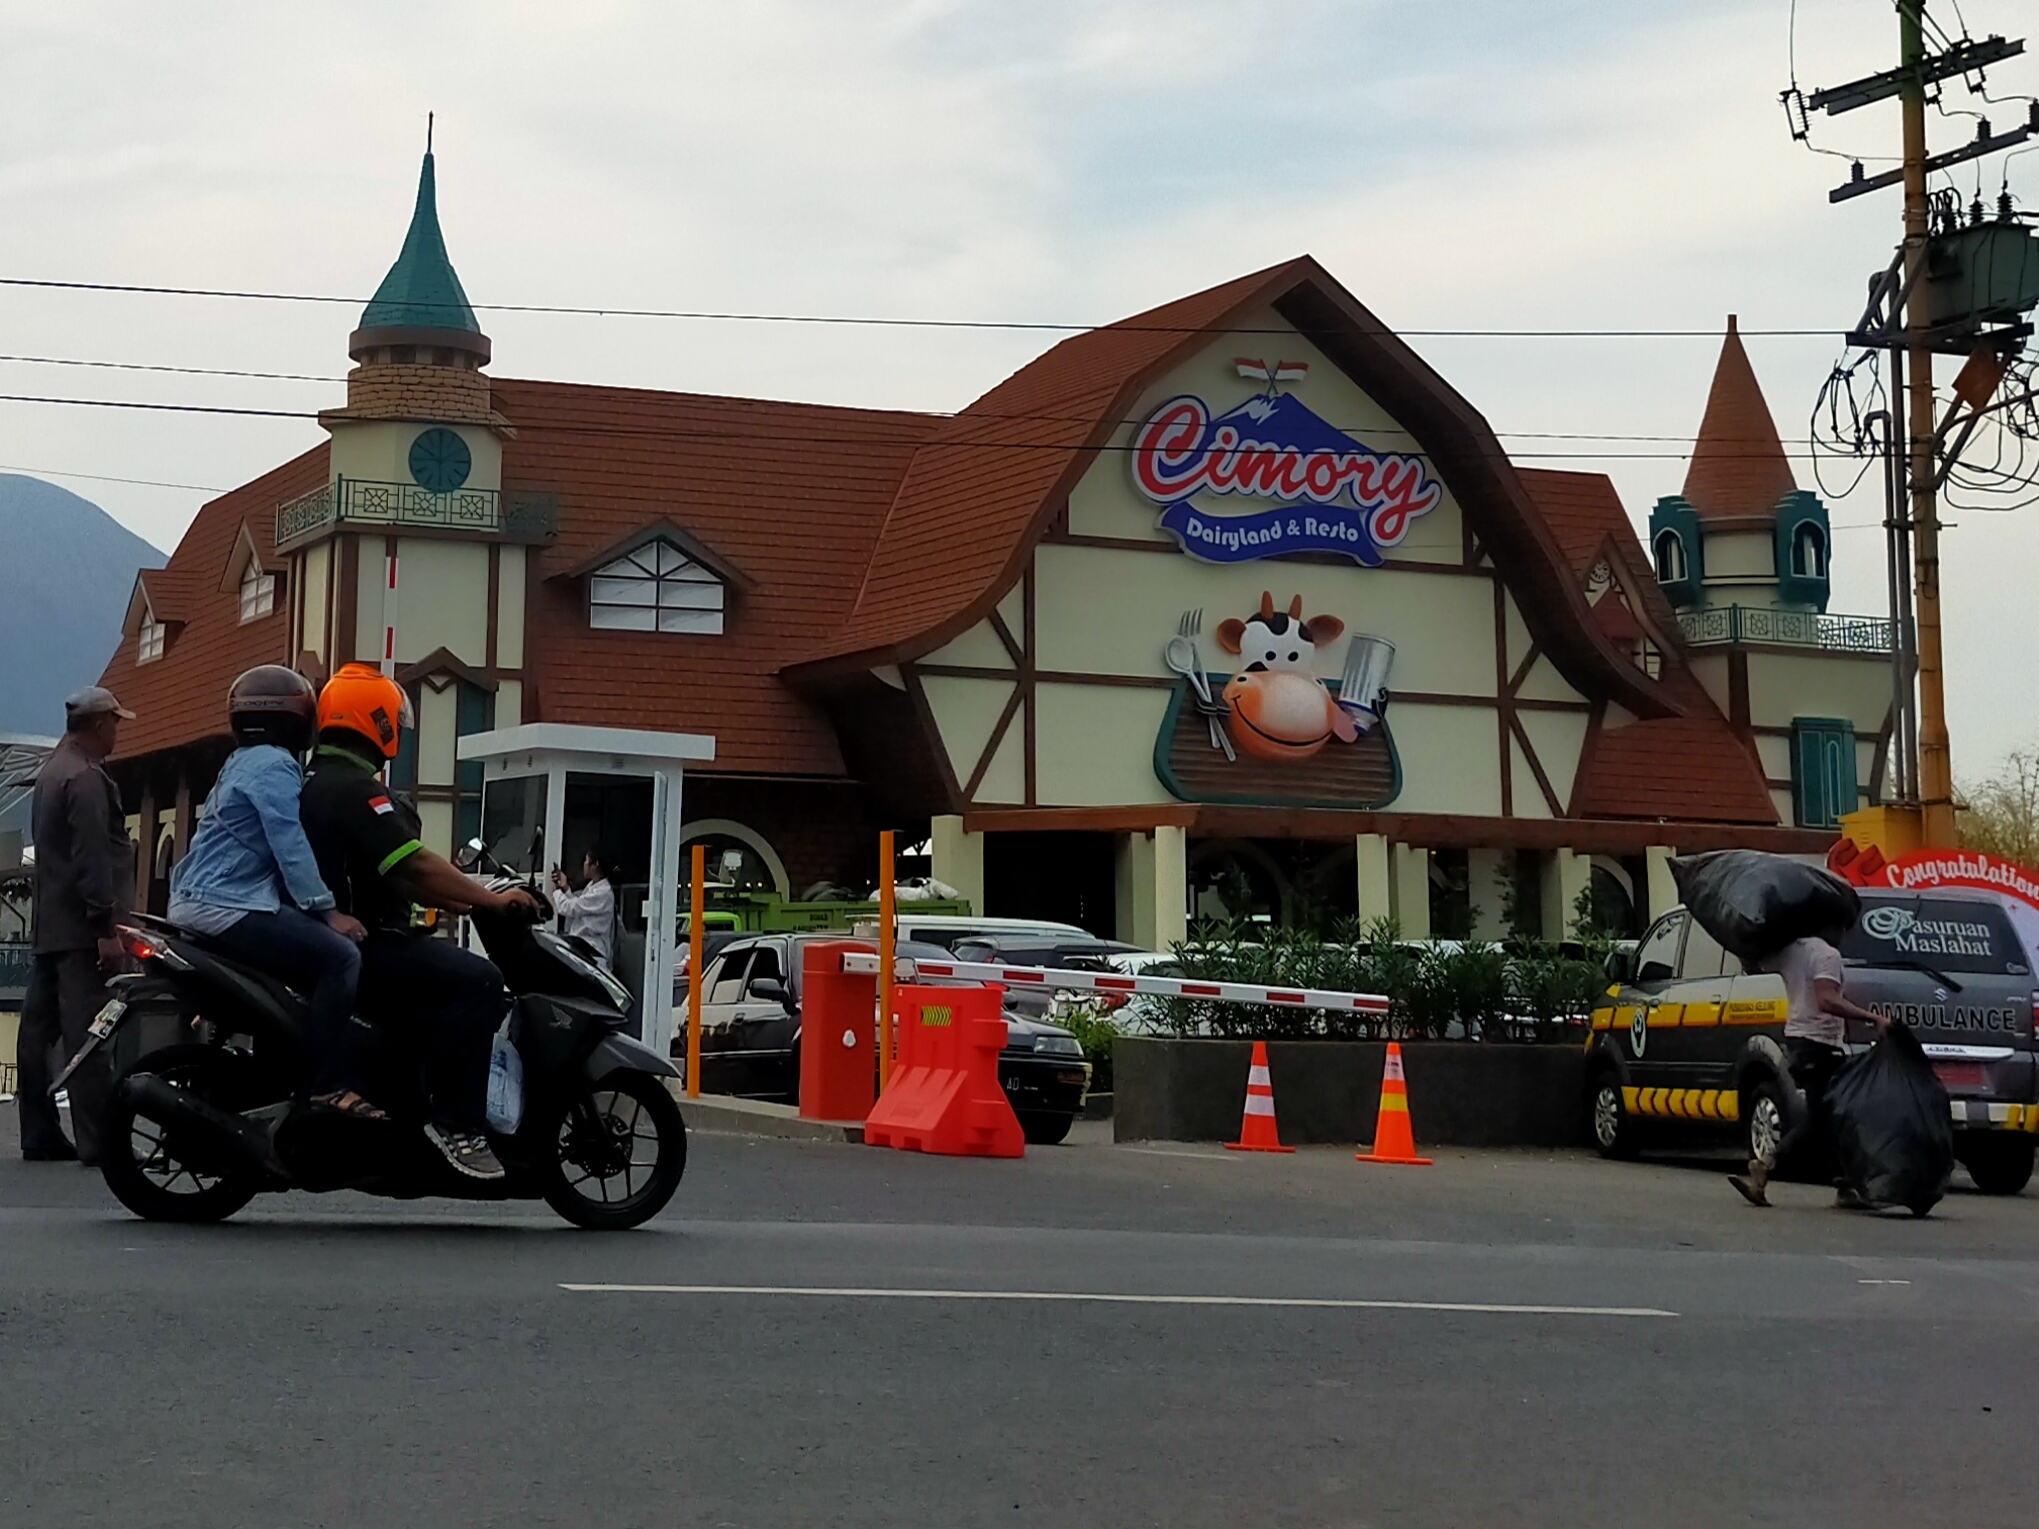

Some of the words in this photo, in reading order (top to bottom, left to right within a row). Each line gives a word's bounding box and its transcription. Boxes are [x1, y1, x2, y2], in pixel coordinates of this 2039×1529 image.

[1135, 401, 1440, 544] Cimory
[1187, 517, 1283, 551] Dairyland
[1286, 519, 1300, 536] &
[1305, 517, 1359, 542] Resto
[1895, 934, 1992, 956] Maslahat
